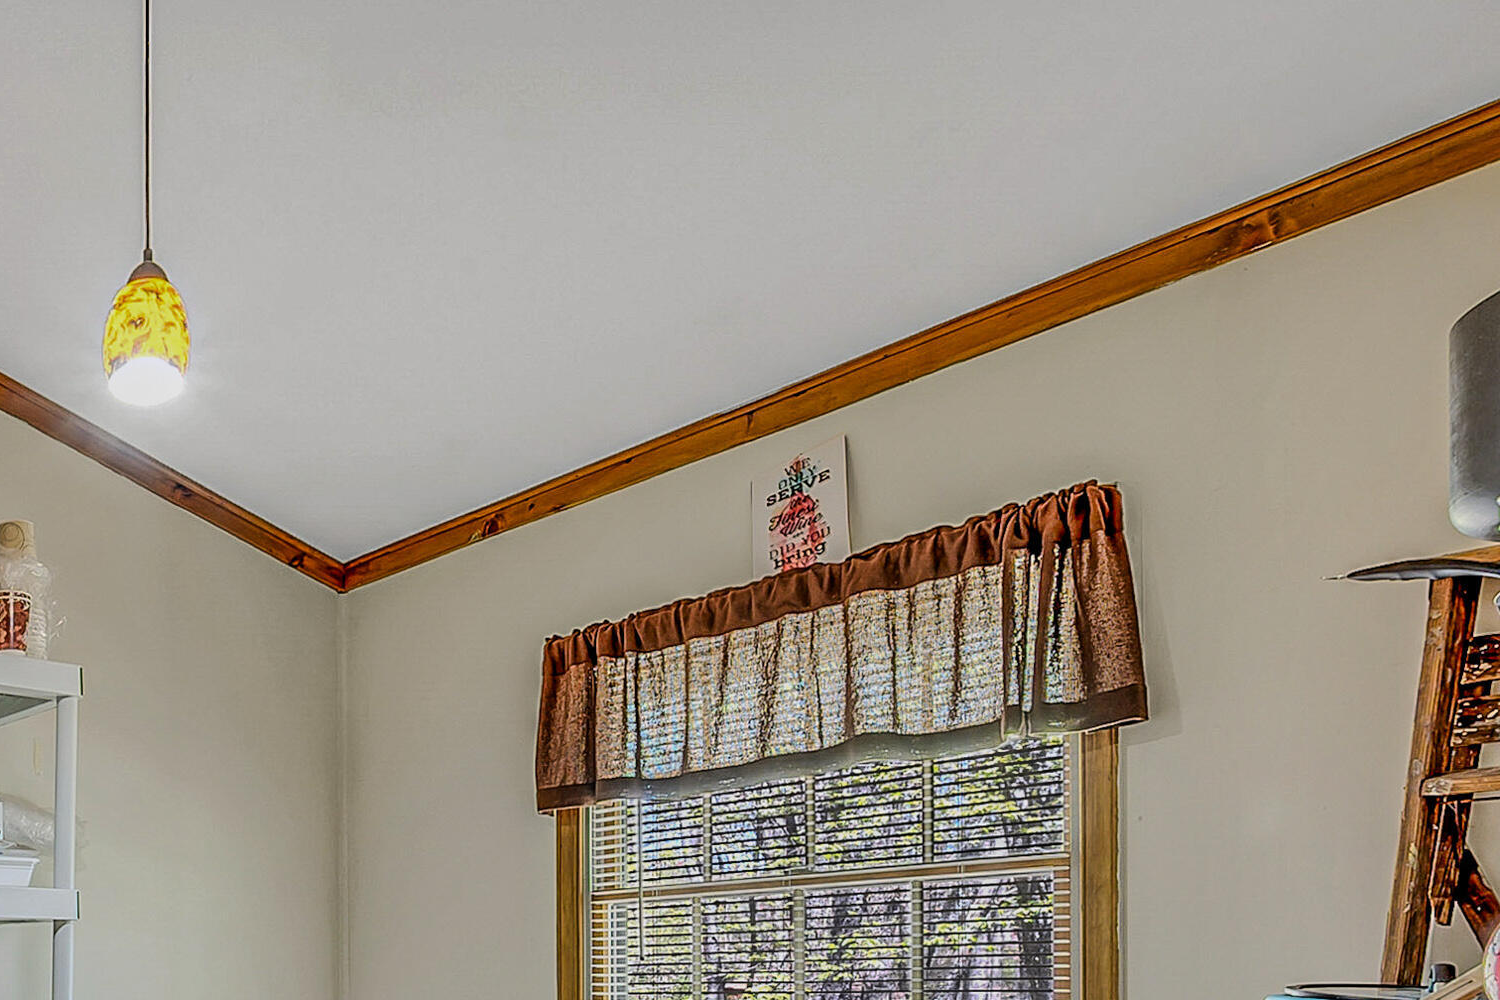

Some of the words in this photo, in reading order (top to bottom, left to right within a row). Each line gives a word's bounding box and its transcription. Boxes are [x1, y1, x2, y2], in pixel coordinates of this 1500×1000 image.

[779, 465, 816, 490] ONLY
[784, 457, 811, 476] WE
[766, 469, 830, 507] SERVE
[780, 512, 824, 537] Wine
[769, 541, 796, 561] DID
[801, 526, 831, 546] YOU
[773, 541, 827, 570] bring
